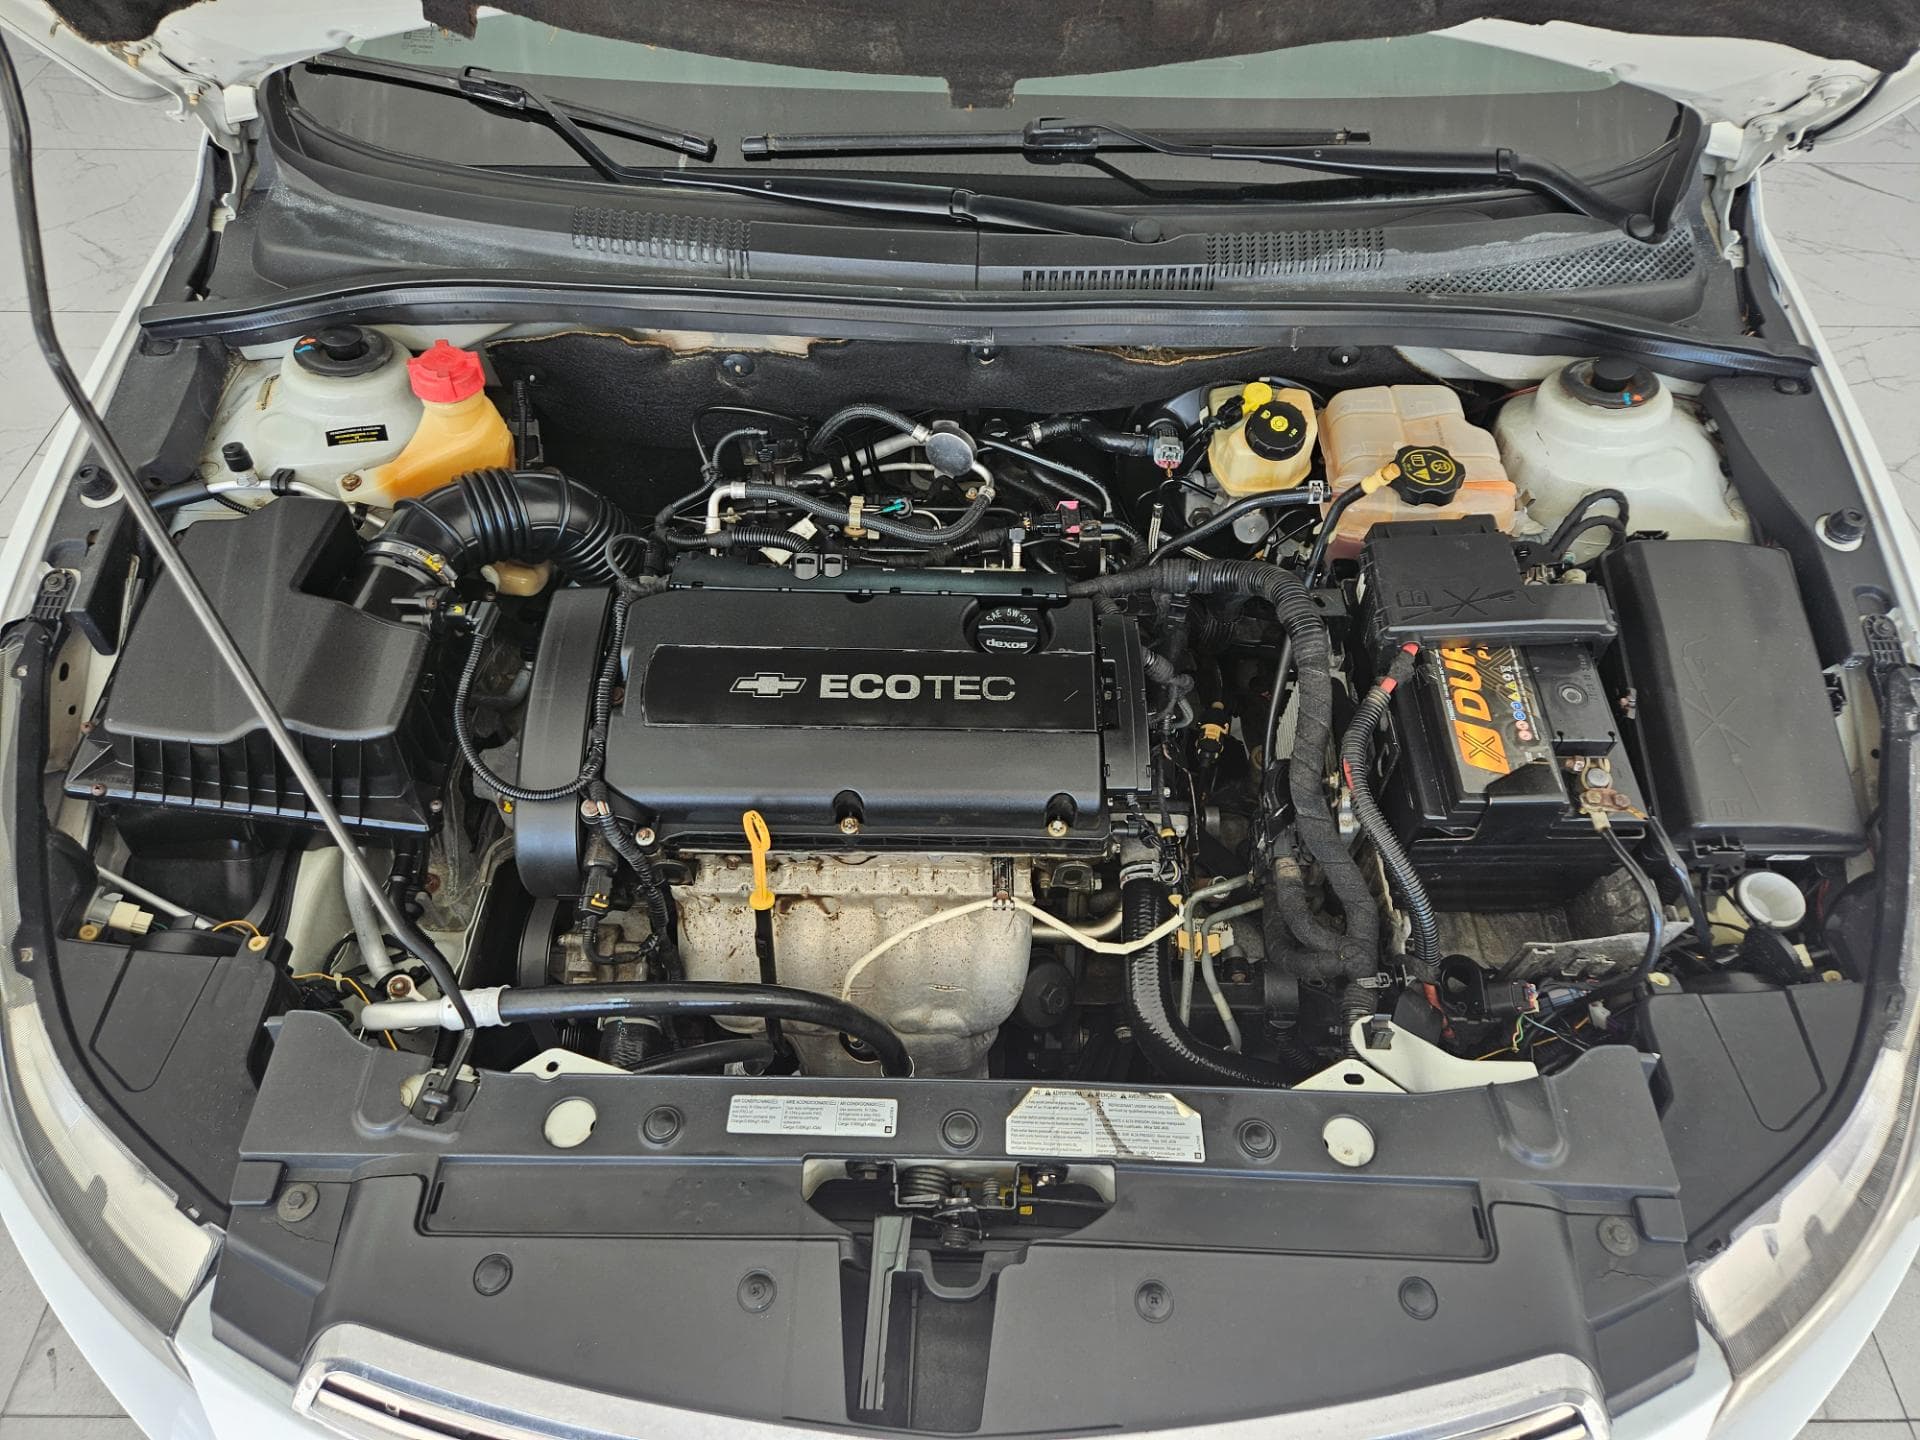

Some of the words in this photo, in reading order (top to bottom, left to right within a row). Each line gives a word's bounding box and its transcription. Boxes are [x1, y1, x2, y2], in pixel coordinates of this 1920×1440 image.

[985, 609, 1002, 622] SAE
[1006, 608, 1031, 625] 5W-30
[986, 638, 1028, 649] dexos
[819, 673, 1016, 701] ECOTEC
